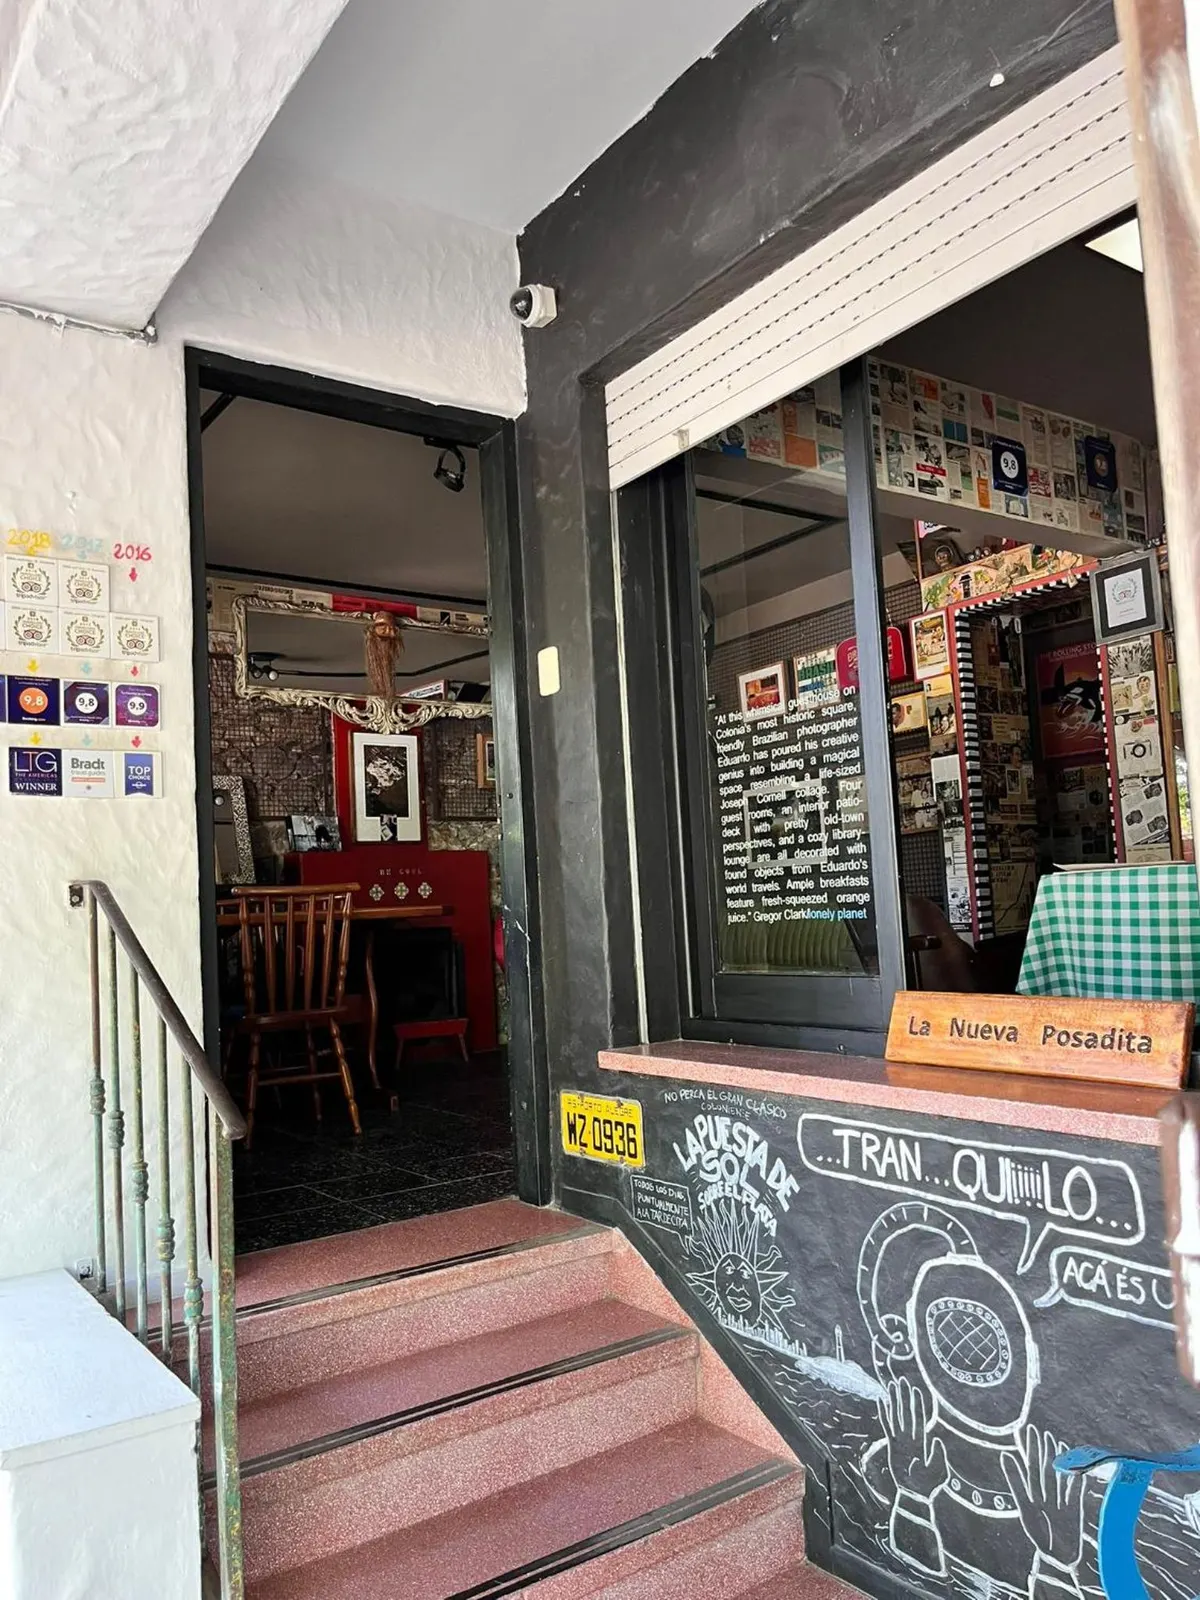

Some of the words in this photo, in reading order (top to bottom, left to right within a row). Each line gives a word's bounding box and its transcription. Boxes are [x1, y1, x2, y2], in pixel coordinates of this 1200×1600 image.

[8, 528, 51, 549] 2018
[113, 543, 152, 561] 2016
[24, 695, 44, 706] 9,8
[78, 698, 95, 707] 9,8
[729, 710, 743, 722] this
[843, 685, 856, 696] on
[715, 723, 751, 740] Colonia's
[757, 716, 778, 730] most
[783, 710, 816, 725] historic
[821, 701, 857, 717] square,
[752, 730, 788, 746] Brazilian
[796, 716, 858, 739] photographer
[753, 750, 769, 760] has
[771, 743, 802, 759] poured
[804, 739, 818, 751] his
[822, 732, 859, 747] creative
[14, 751, 57, 772] LTG
[71, 758, 105, 770] Bradt
[128, 766, 150, 774] TOP
[718, 768, 744, 784] genius
[750, 765, 765, 776] into
[770, 757, 804, 773] building
[810, 756, 817, 765] a
[823, 746, 860, 764] magical
[15, 782, 57, 791] WINNER
[719, 785, 743, 798] space
[804, 772, 810, 782] a
[819, 762, 861, 780] life-sized
[720, 796, 748, 810] Joseph
[756, 791, 786, 804] Cornell
[839, 780, 863, 792] Four
[720, 813, 743, 826] guest
[781, 806, 793, 815] an
[798, 800, 829, 813] interior
[722, 827, 741, 838] deck
[753, 823, 771, 834] with
[784, 818, 809, 831] pretty
[824, 812, 864, 826] old-town
[778, 834, 794, 845] and
[798, 835, 804, 843] a
[807, 831, 829, 844] cozy
[723, 856, 750, 867] lounge
[757, 853, 770, 863] are
[777, 850, 787, 860] all
[794, 846, 839, 860] decorated
[847, 842, 867, 855] with
[725, 869, 747, 880] found
[754, 866, 784, 879] objects
[792, 864, 812, 875] from
[820, 859, 868, 873] Eduardo's
[725, 883, 747, 894] world
[786, 879, 814, 892] Ample
[820, 875, 869, 888] breakfasts
[726, 897, 754, 908] feature
[762, 893, 828, 908] fresh-squeezed
[836, 894, 870, 905] orange
[753, 911, 782, 924] Gregor
[837, 907, 867, 921] planet
[909, 1015, 931, 1036] La
[949, 1017, 1018, 1043] Nueva
[1041, 1024, 1153, 1054] Posadita
[664, 1090, 678, 1104] NO
[707, 1089, 718, 1101] EL
[720, 1091, 743, 1106] GRAN
[693, 1114, 769, 1181] PUESTA
[766, 1157, 801, 1212] DE
[700, 1149, 760, 1199] SOL
[634, 1179, 655, 1191] TODOS
[656, 1185, 668, 1195] LOS
[725, 1182, 742, 1201] EL
[637, 1192, 689, 1217] PUNTUALMENTE
[650, 1208, 689, 1230] TARDECITA
[1063, 1256, 1112, 1298] ACÁ
